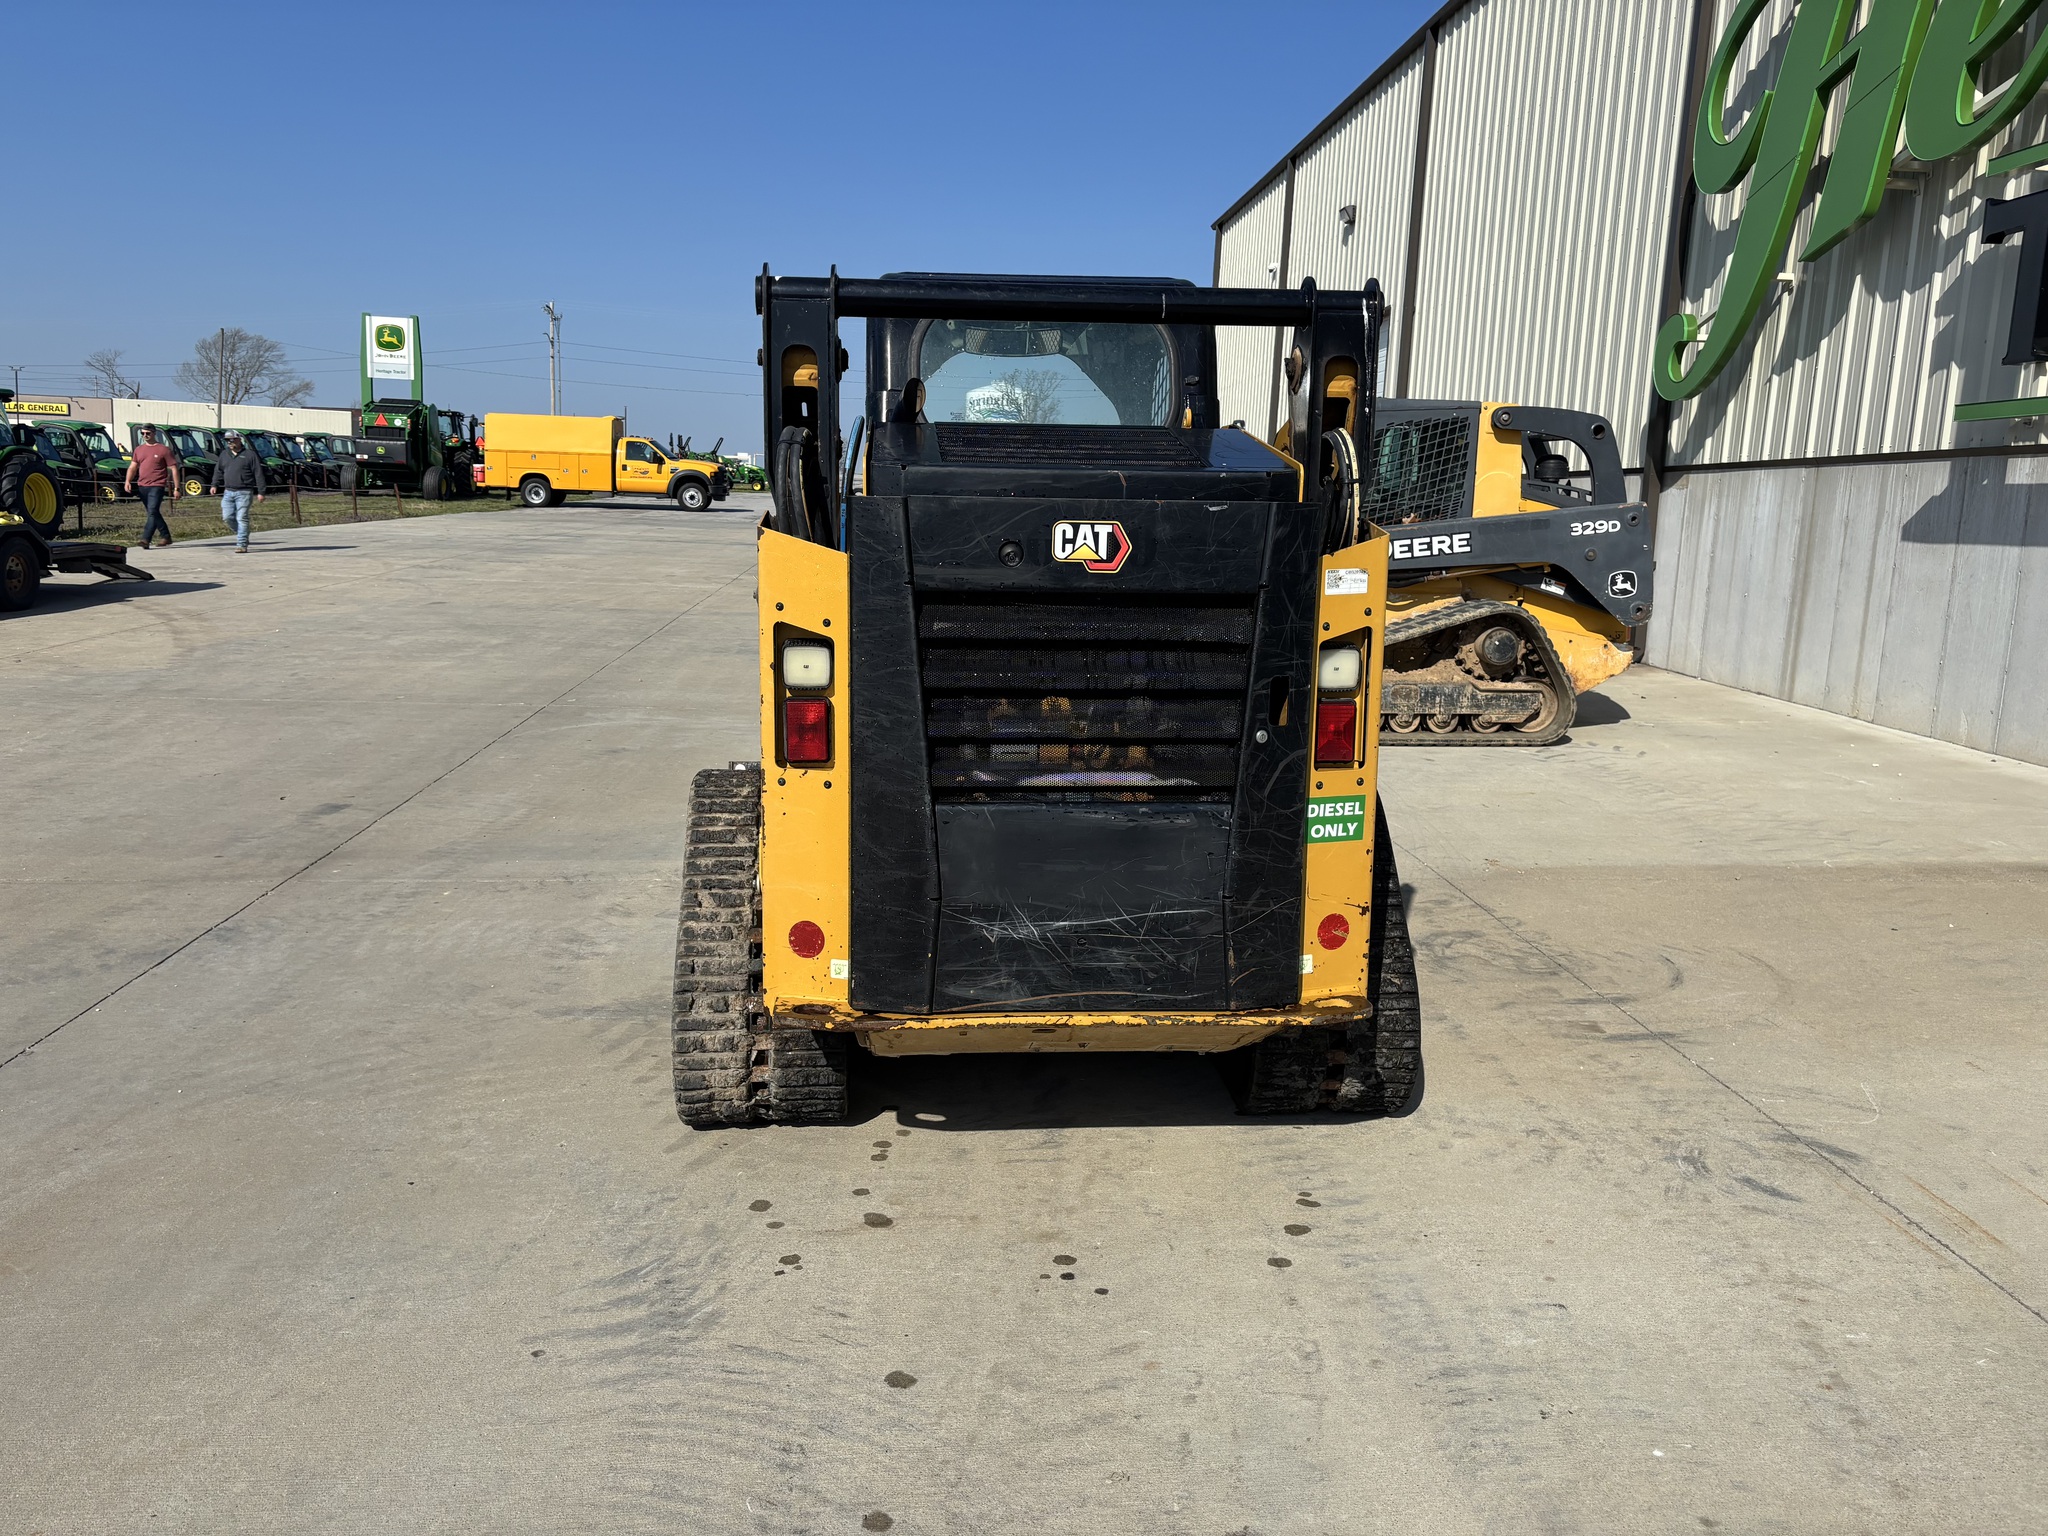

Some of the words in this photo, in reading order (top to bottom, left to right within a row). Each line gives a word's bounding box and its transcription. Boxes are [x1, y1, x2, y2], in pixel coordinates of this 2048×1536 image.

[28, 404, 65, 412] GENERAL
[1570, 519, 1621, 536] 329D
[1054, 522, 1113, 560] CAT
[1388, 533, 1471, 560] EERE
[1307, 801, 1364, 818] DIESEL
[1310, 822, 1359, 839] ONLY
